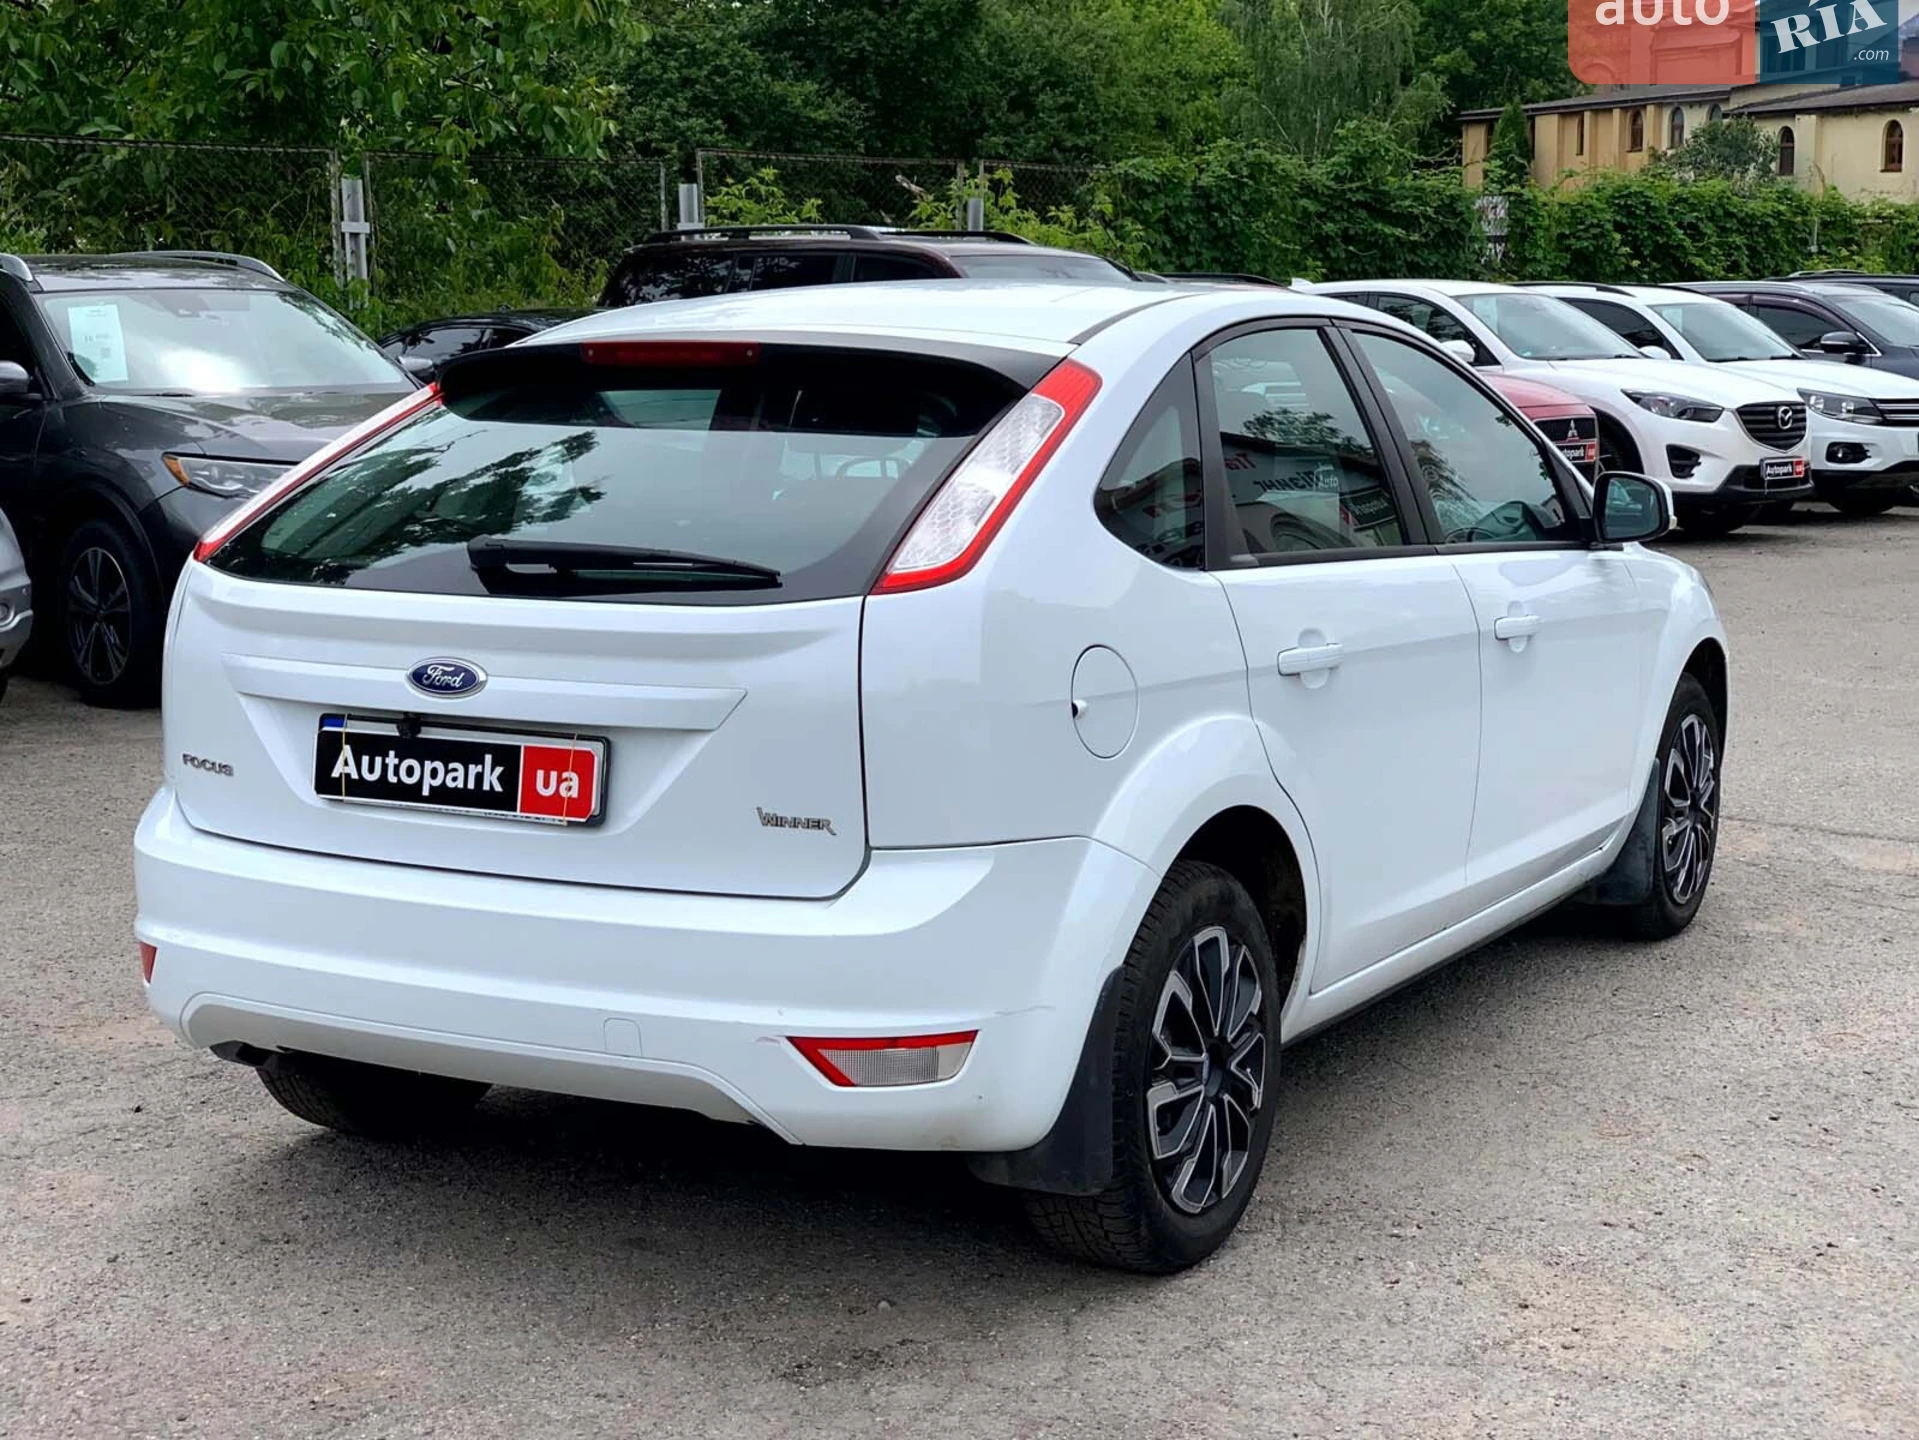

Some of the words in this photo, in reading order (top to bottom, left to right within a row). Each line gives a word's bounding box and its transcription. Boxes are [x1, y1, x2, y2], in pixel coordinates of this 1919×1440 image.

[422, 664, 465, 688] Ford
[182, 753, 234, 777] FOCUS
[330, 744, 505, 797] Autopark
[536, 769, 580, 799] ua
[756, 806, 837, 836] WINNER
